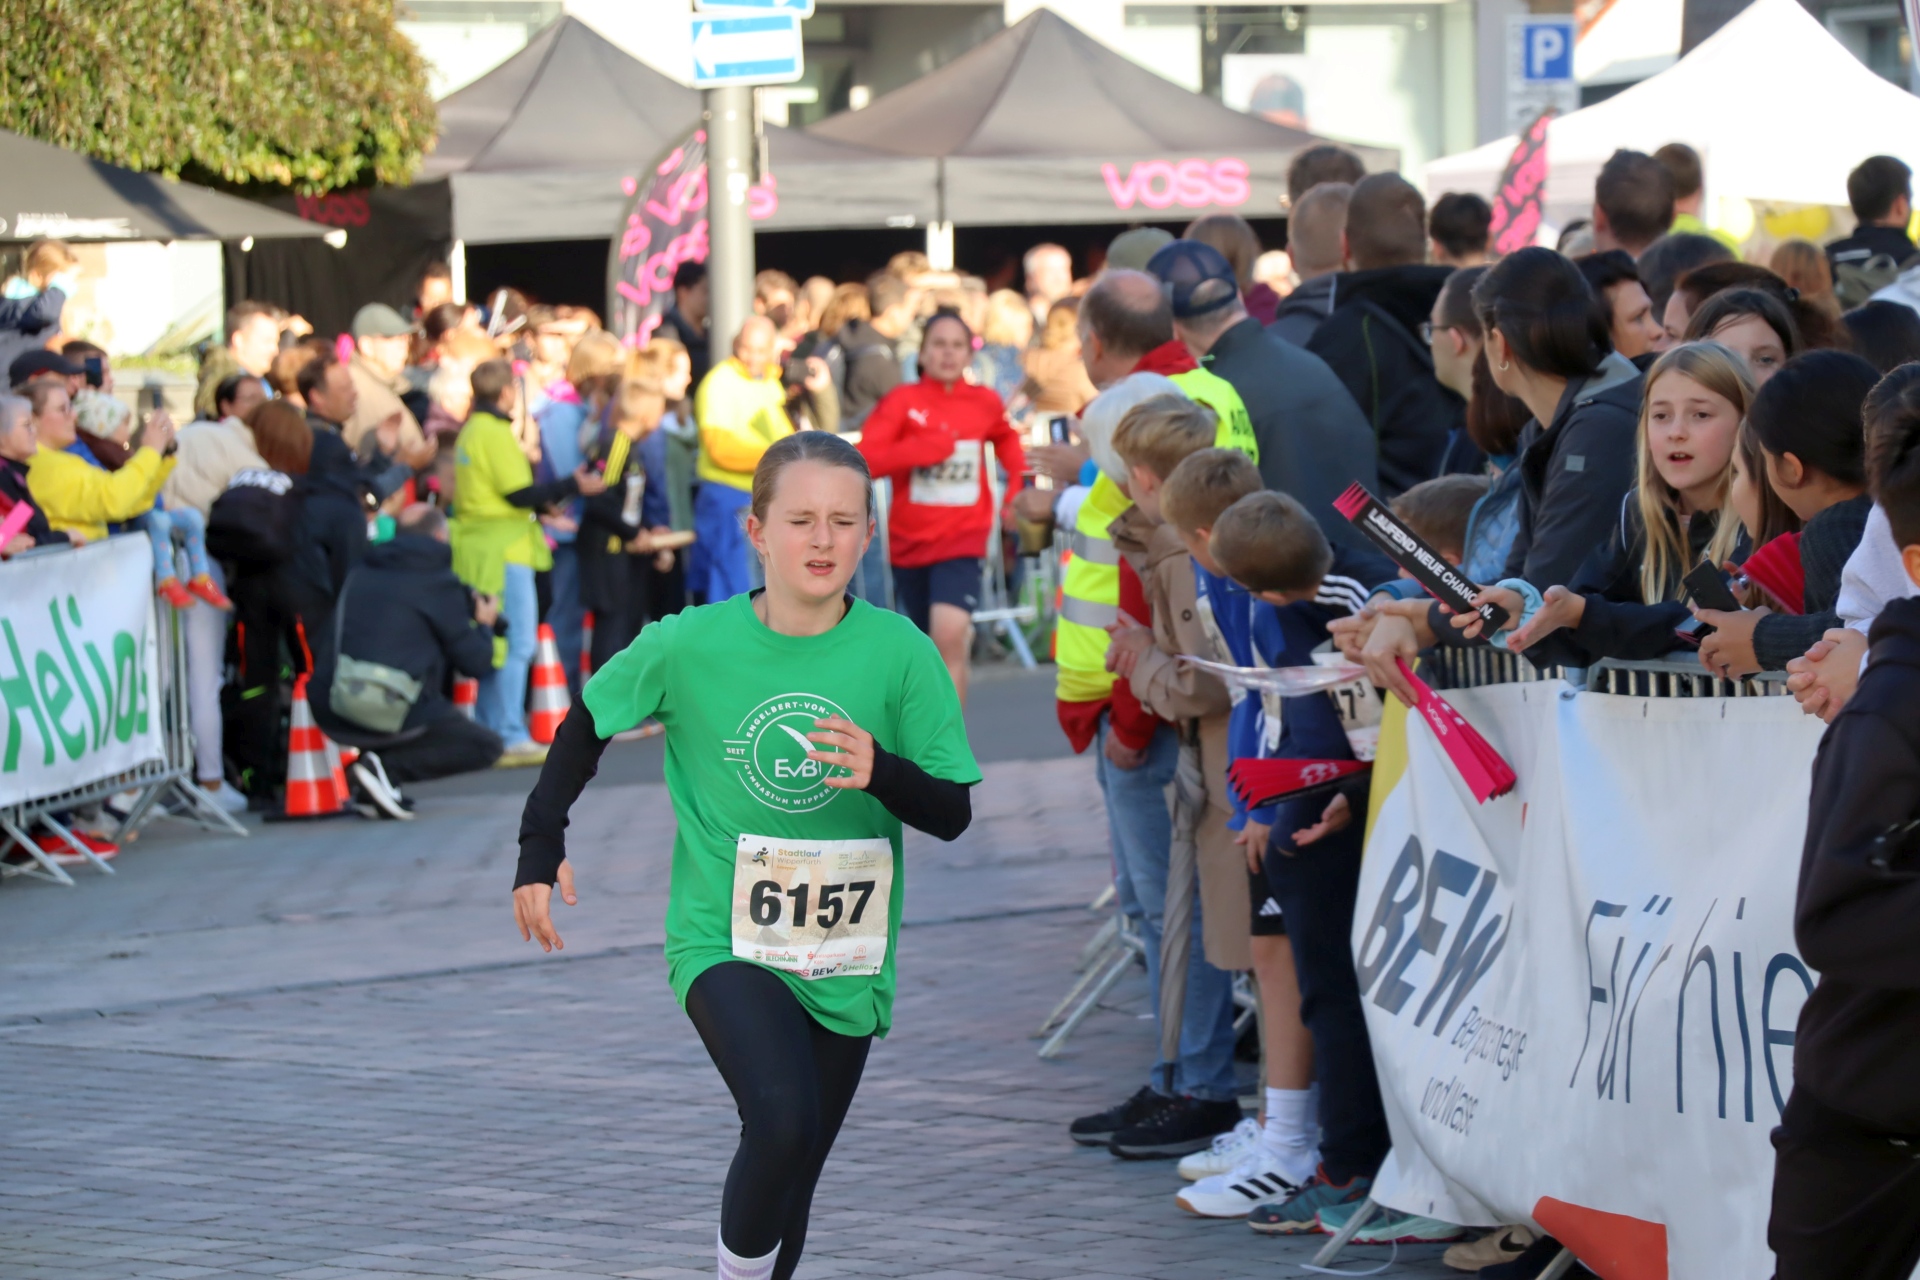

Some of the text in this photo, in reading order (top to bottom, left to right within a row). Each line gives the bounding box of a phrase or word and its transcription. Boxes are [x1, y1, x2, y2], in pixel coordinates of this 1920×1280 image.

[1530, 28, 1564, 77] P
[1101, 157, 1251, 210] VOSS
[1367, 507, 1417, 553] LAUFEND
[1413, 547, 1446, 577] NEUE
[1426, 702, 1448, 736] VOSS
[726, 748, 745, 756] SEIT
[744, 764, 789, 805] GYMNASIUM
[777, 848, 822, 858] Stadtlauf
[777, 857, 822, 866] Wipperfürth
[750, 880, 876, 929] 6157
[1357, 833, 1515, 1037] BEW
[811, 966, 838, 977] BEW
[848, 963, 874, 971] Helios
[1569, 894, 1816, 1124] Für hie
